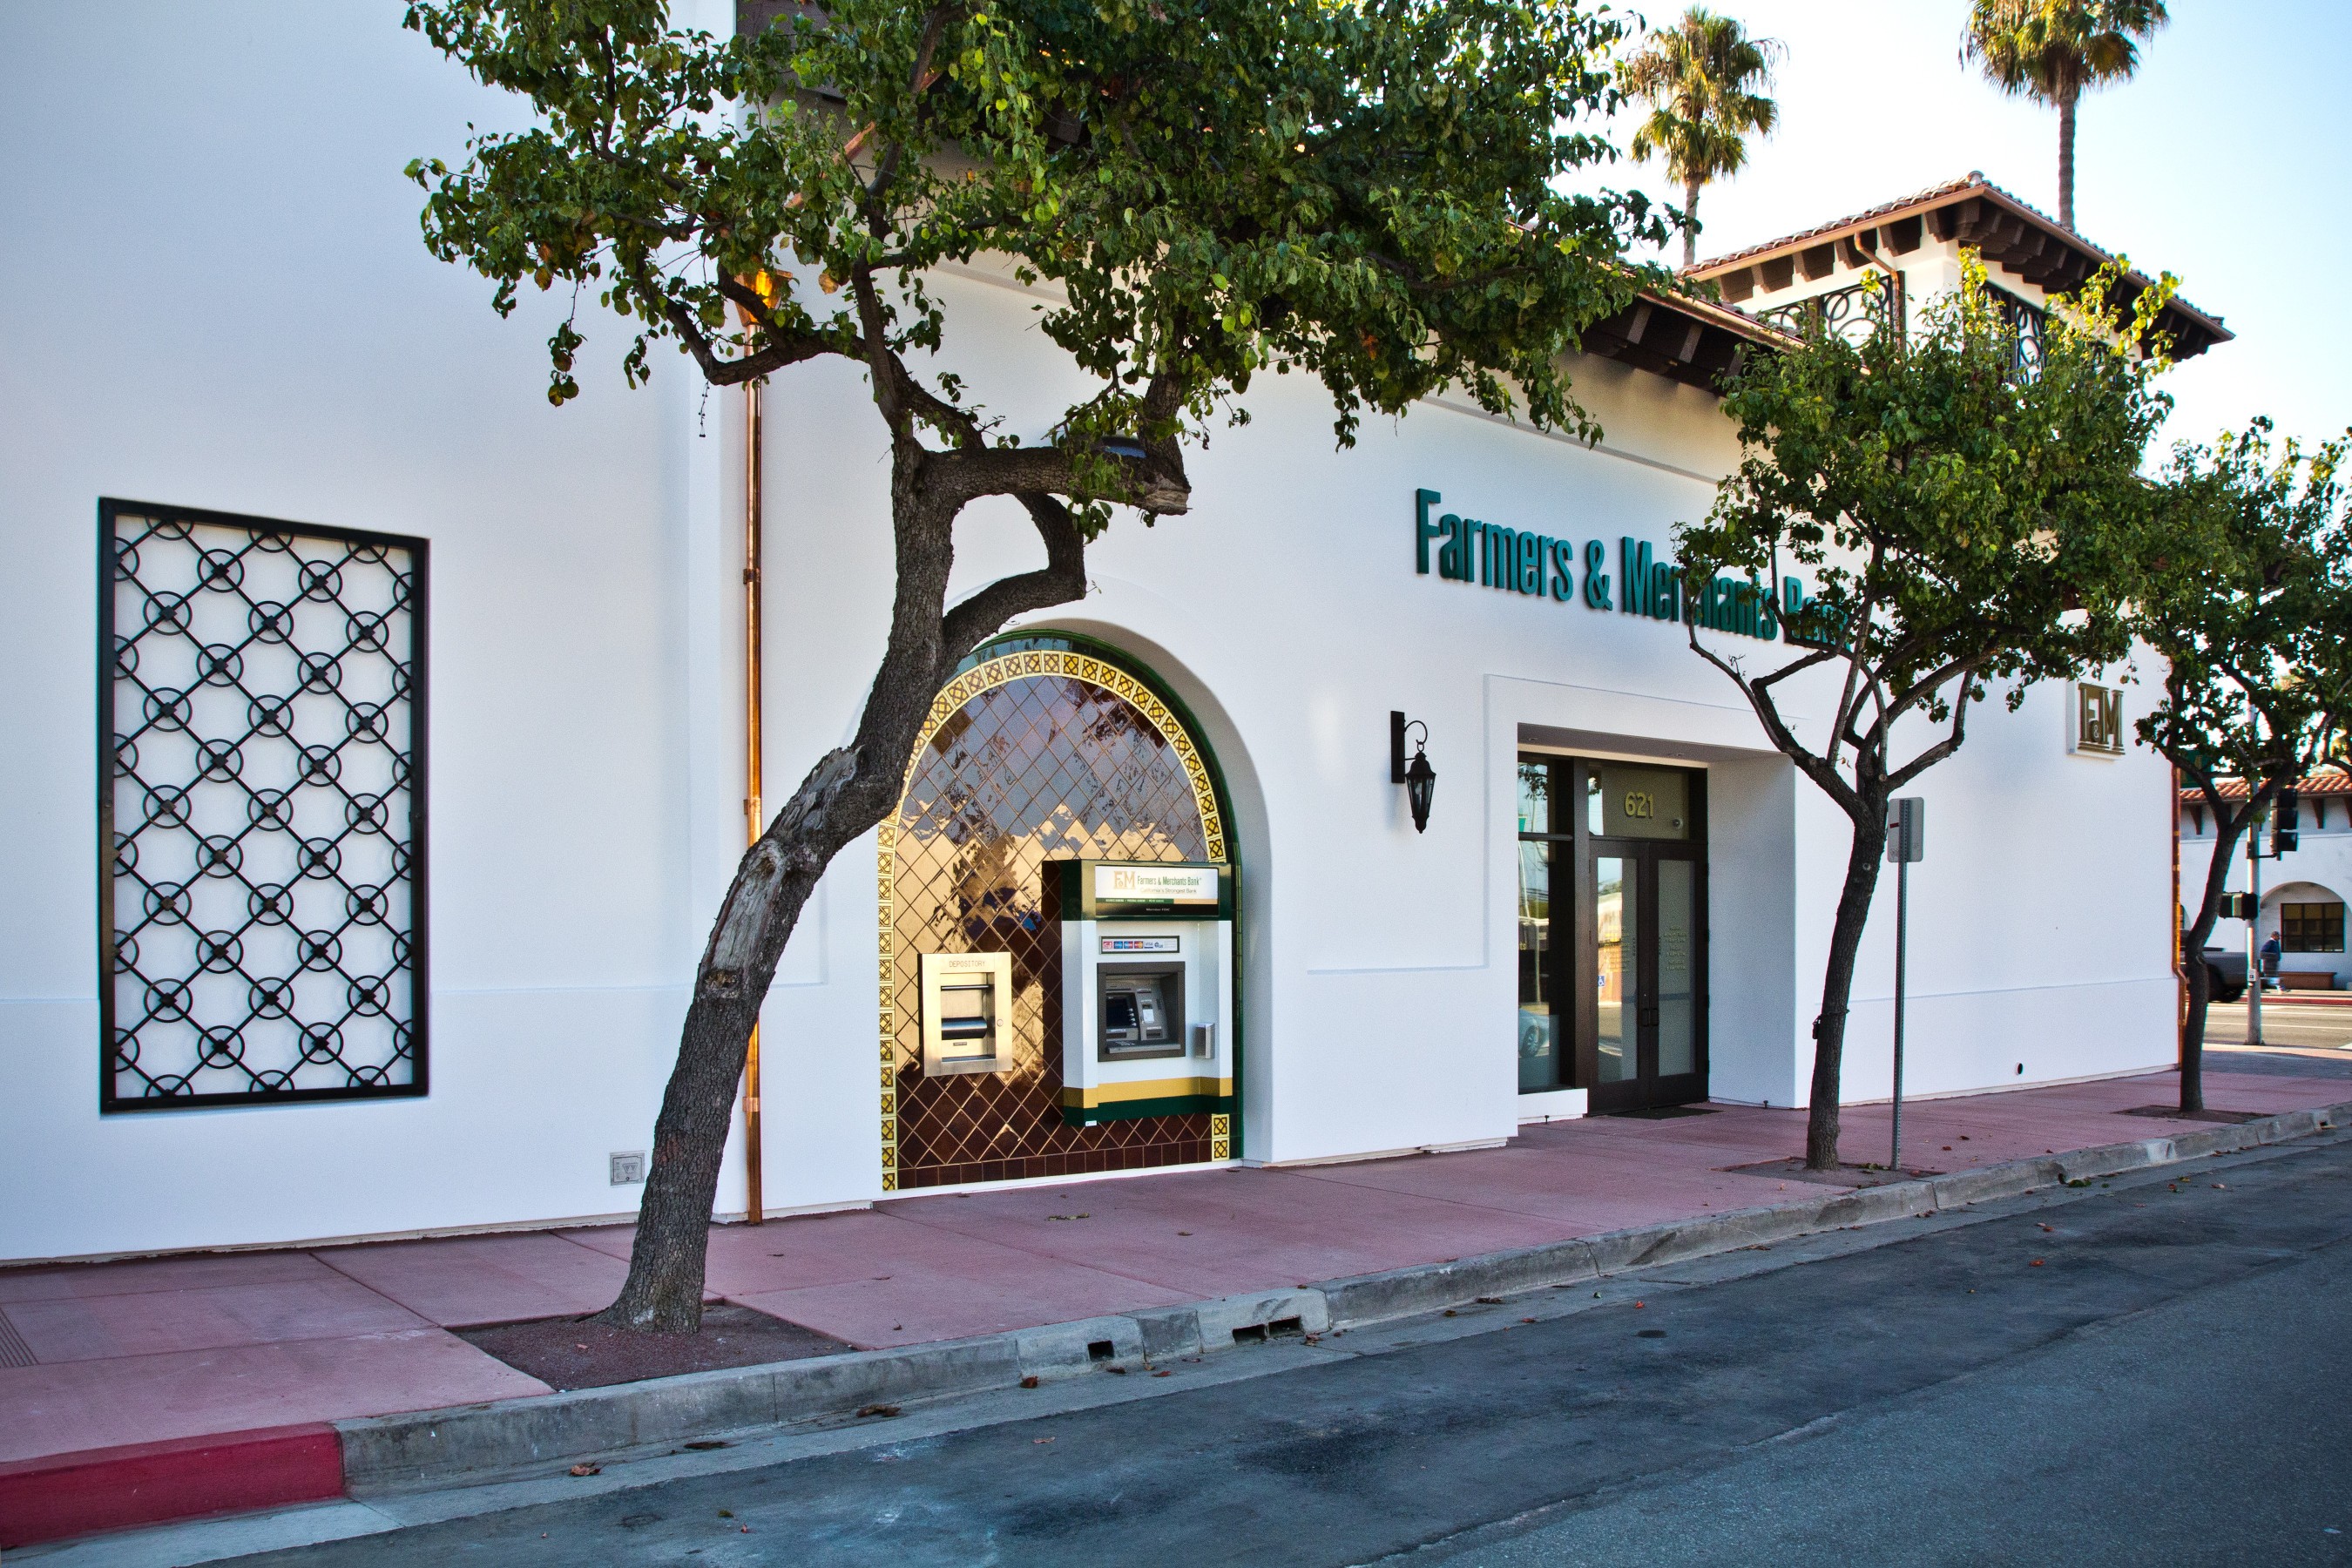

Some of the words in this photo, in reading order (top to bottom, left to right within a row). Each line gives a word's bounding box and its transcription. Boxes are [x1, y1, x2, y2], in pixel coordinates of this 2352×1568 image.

[1416, 488, 1574, 602] Farmers
[1586, 539, 1613, 611] &
[1625, 791, 1654, 818] 621
[1137, 875, 1157, 885] Farmers
[1157, 876, 1161, 885] &
[1162, 876, 1186, 886] Merchants
